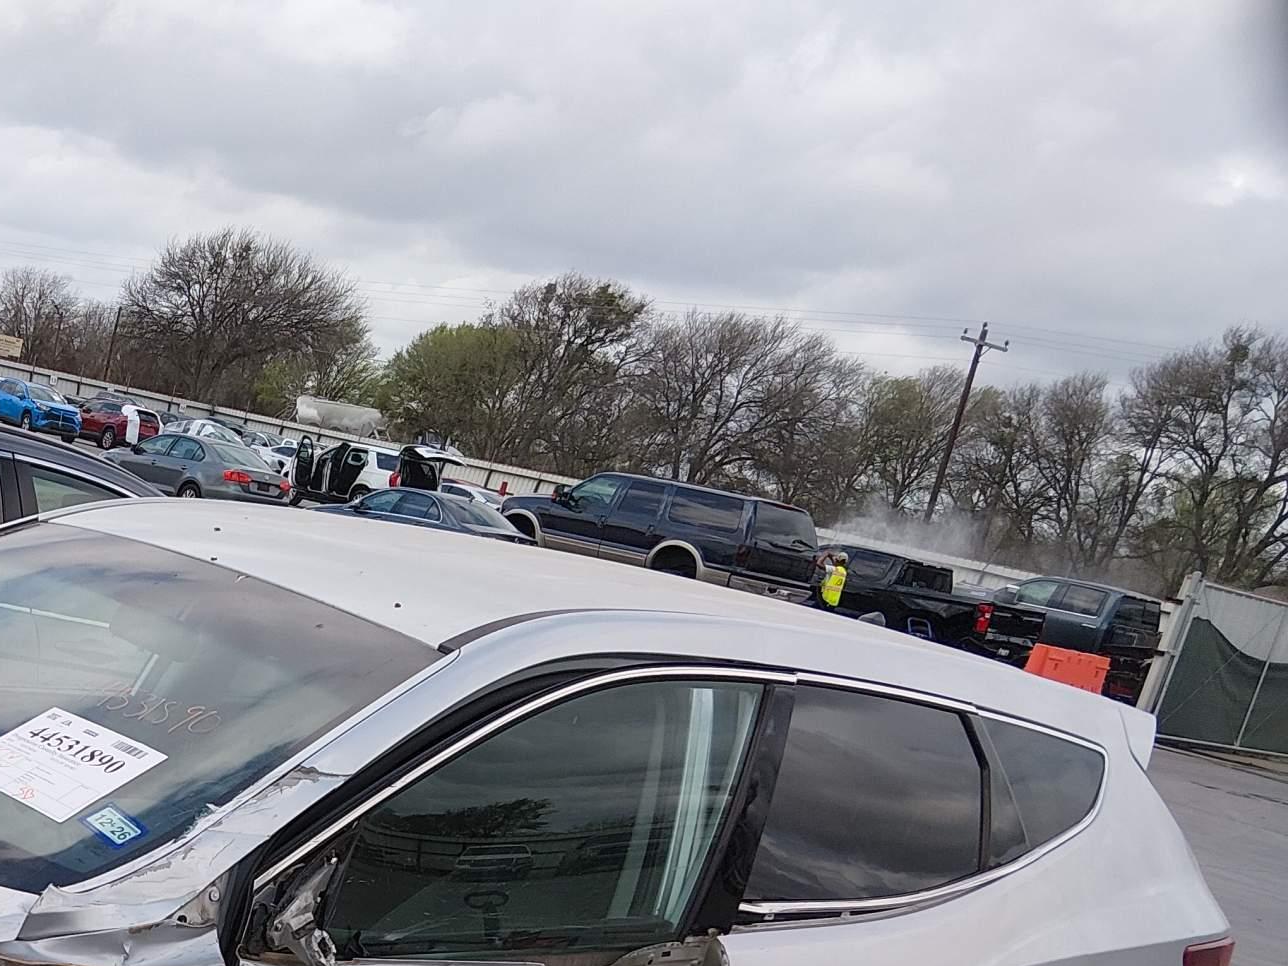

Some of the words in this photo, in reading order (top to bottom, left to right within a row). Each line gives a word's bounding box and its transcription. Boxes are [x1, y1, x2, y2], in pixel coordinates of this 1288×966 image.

[29, 727, 126, 774] 44531890
[95, 814, 114, 828] 12
[109, 826, 131, 841] 26
